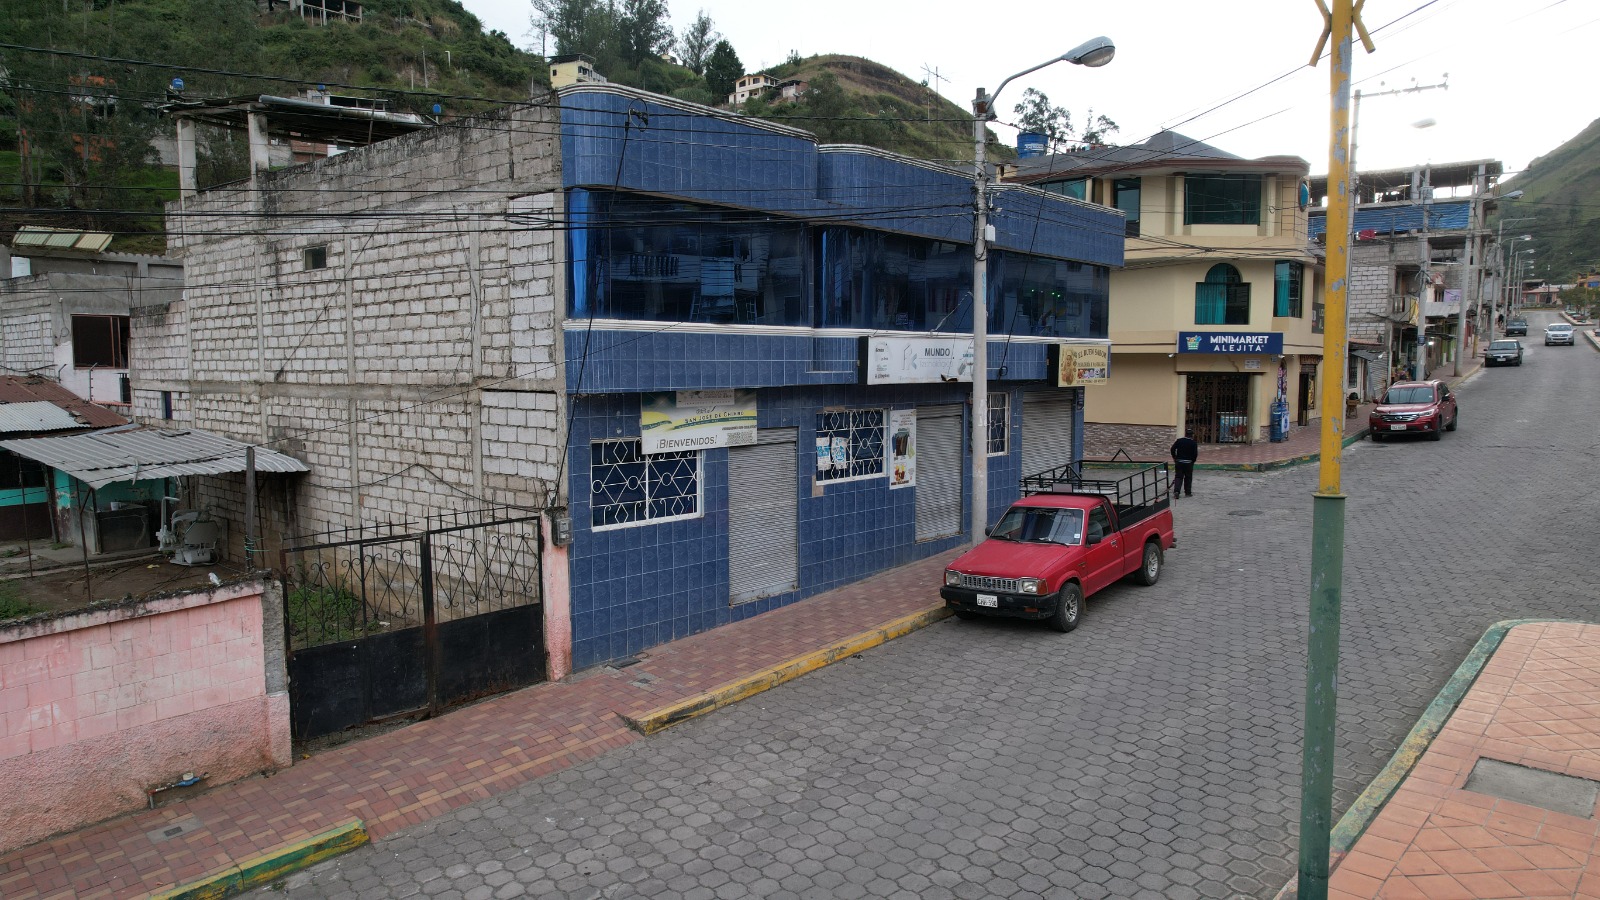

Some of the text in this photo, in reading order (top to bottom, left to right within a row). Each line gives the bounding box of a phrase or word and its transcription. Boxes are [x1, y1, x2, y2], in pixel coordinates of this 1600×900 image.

[1210, 335, 1269, 343] MINIMARKET
[924, 347, 951, 357] MUNDO
[1214, 344, 1262, 352] ALEJITA
[656, 435, 718, 449] ¡BIENVENIDOS!
